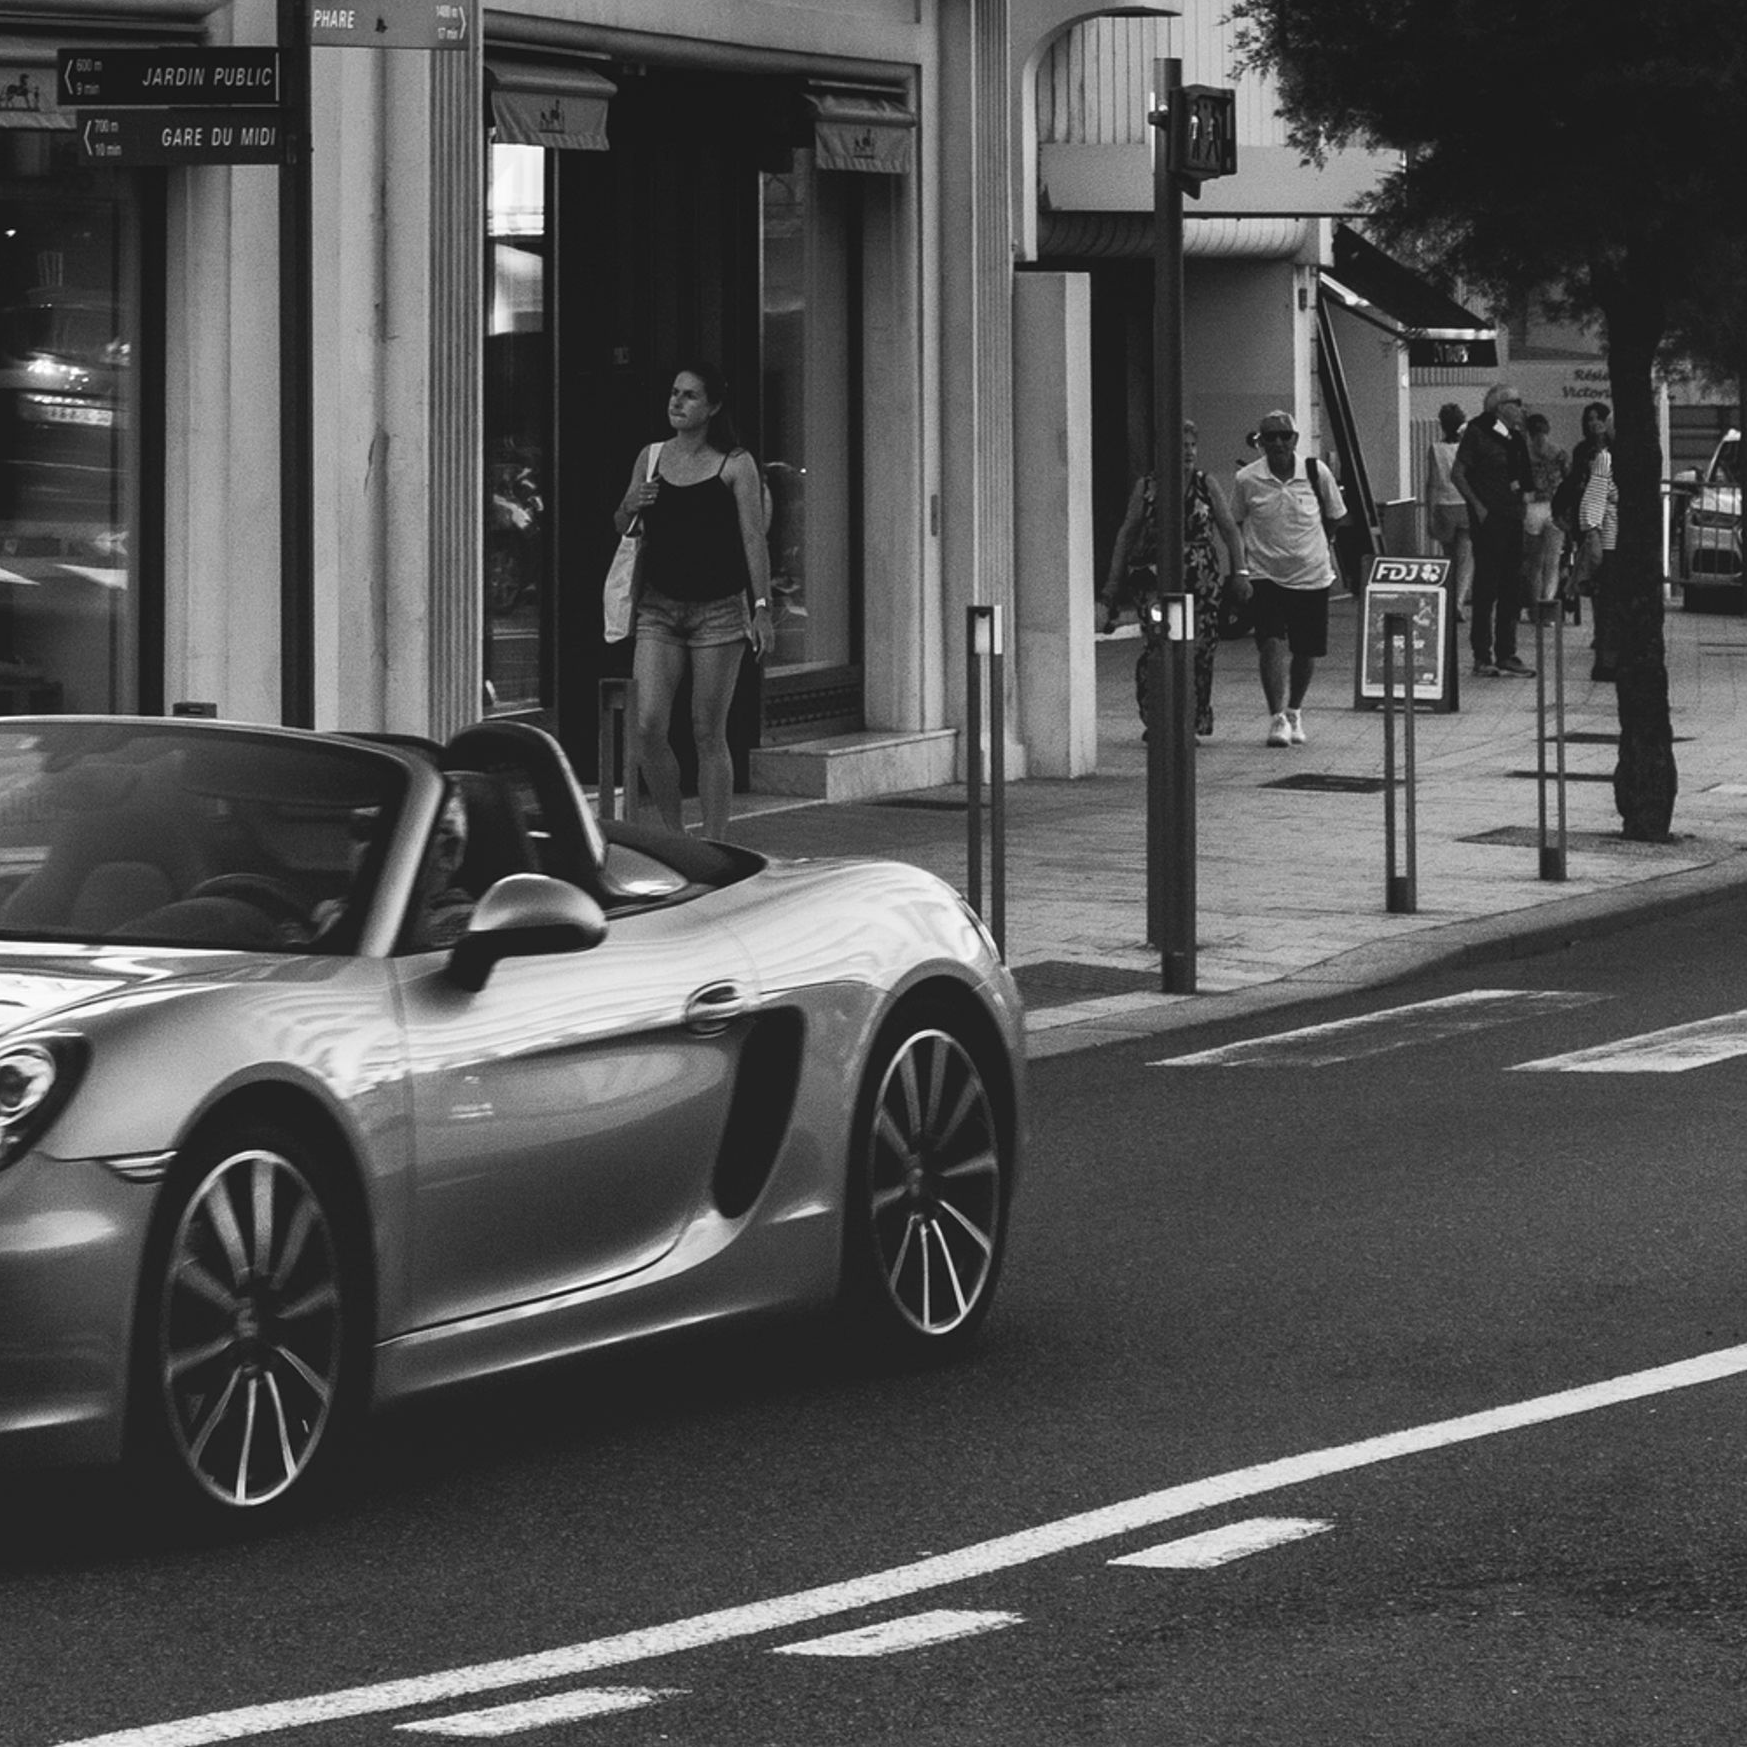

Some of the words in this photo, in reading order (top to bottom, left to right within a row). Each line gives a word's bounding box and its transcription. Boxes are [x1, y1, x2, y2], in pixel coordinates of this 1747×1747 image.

[312, 9, 355, 29] PHARE
[142, 67, 205, 86] JARDIN
[214, 67, 272, 86] PUBLIC
[161, 128, 203, 146] GARE
[211, 128, 233, 146] DU
[240, 128, 276, 146] MIDI
[1376, 563, 1419, 581] FDJ
